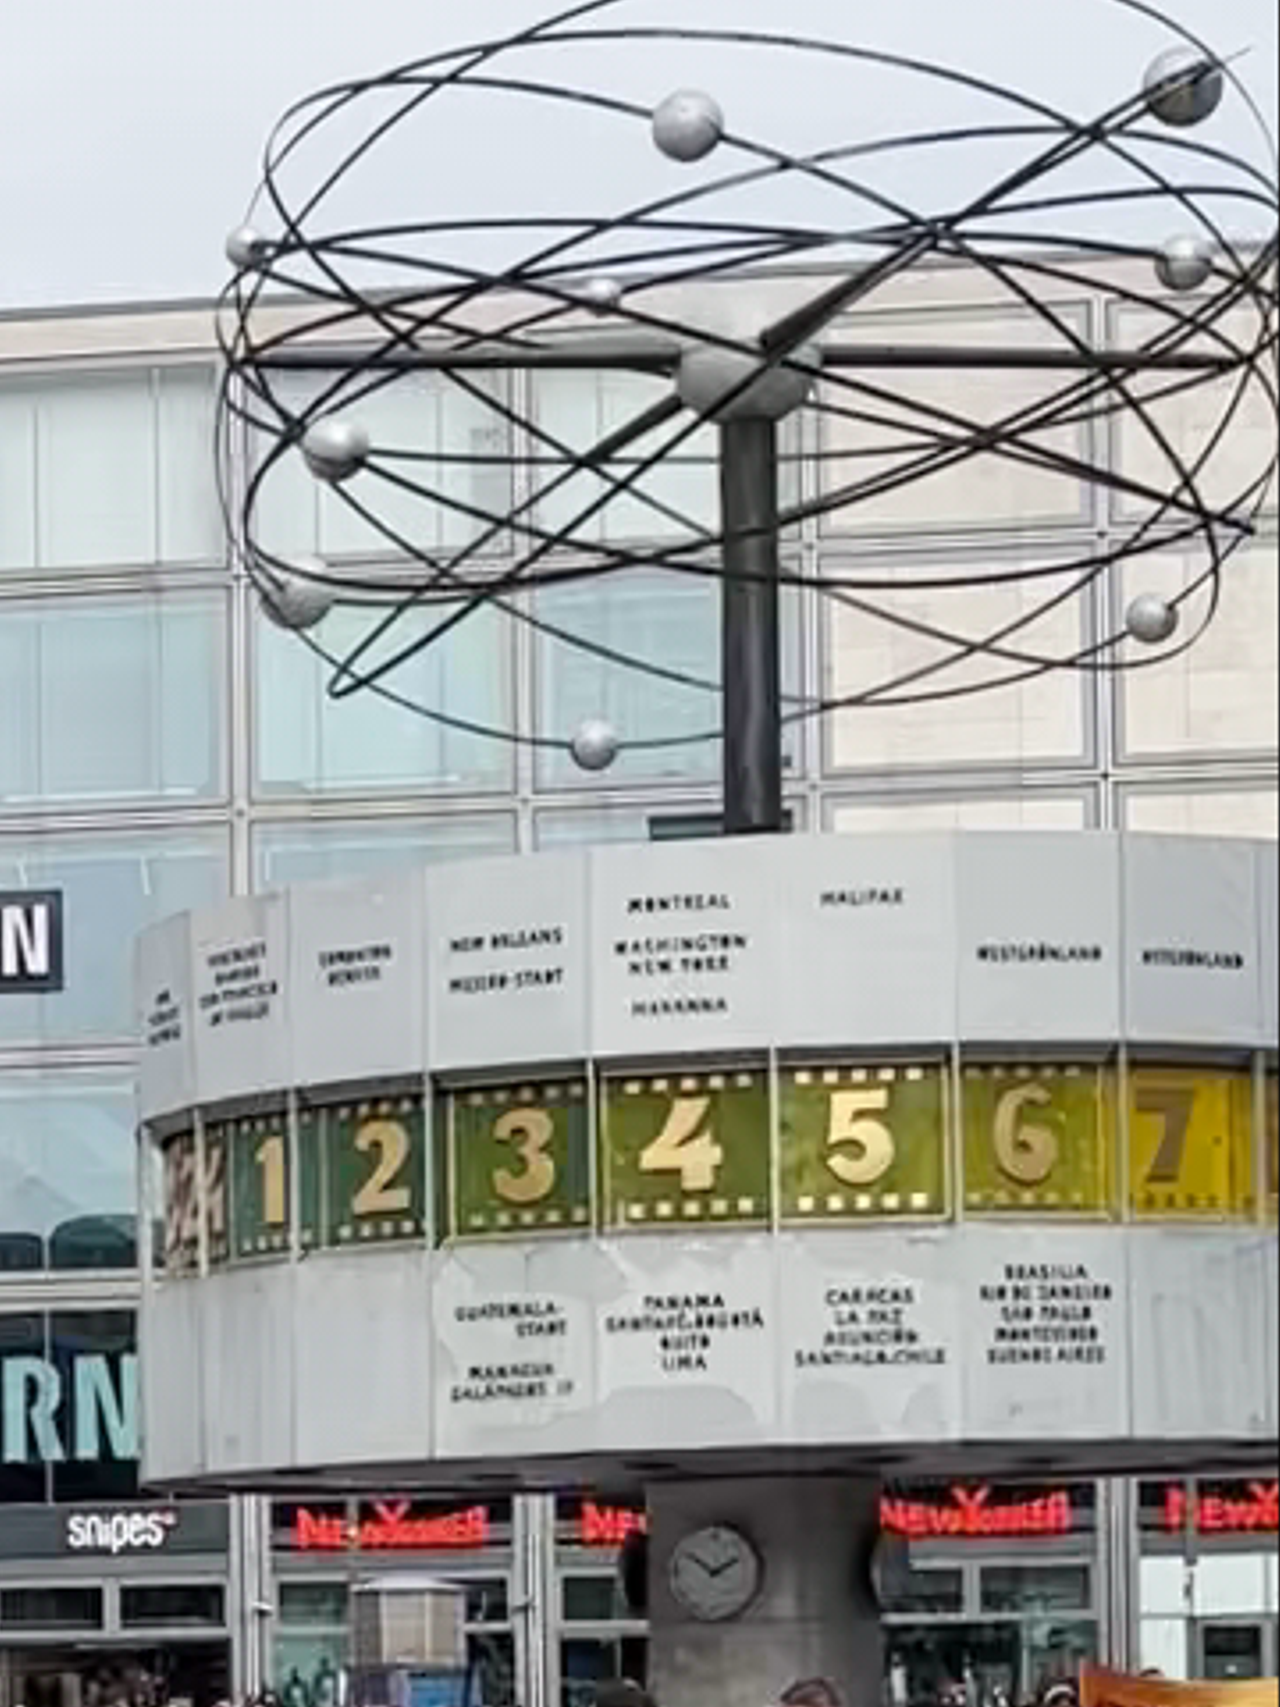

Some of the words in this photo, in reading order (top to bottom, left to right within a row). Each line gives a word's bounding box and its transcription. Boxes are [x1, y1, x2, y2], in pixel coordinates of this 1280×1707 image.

[255, 1136, 285, 1223] 1
[351, 1120, 412, 1216] 2
[493, 1108, 556, 1203] 3
[640, 1096, 723, 1190] 4
[826, 1089, 896, 1185] 5
[993, 1084, 1058, 1184] 6
[1135, 1088, 1199, 1182] 7
[68, 1510, 165, 1553] snipes
